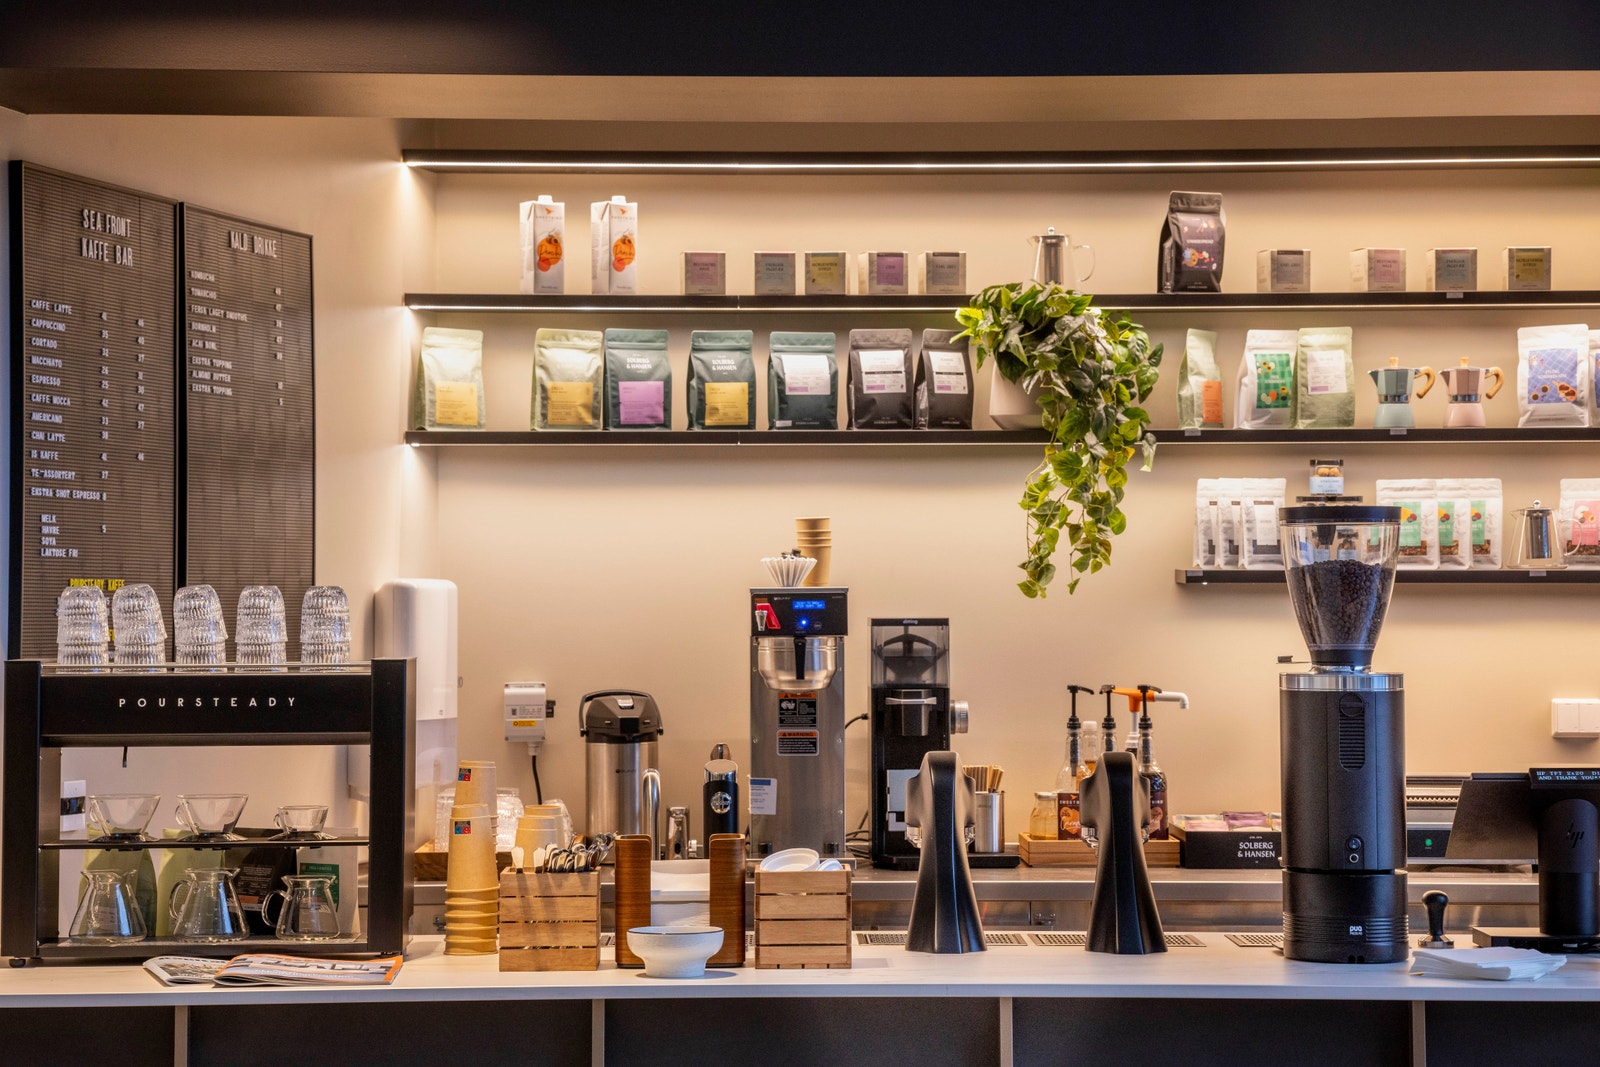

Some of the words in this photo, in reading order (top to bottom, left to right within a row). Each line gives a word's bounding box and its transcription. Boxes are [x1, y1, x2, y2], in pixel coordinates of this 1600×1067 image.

[83, 209, 101, 231] SEA
[106, 214, 131, 237] FRONT
[230, 230, 248, 251] KALD
[253, 235, 277, 258] DRIKKE
[82, 238, 109, 261] KAFFE
[115, 245, 133, 266] BAR
[191, 271, 215, 282] KOMBUCHA
[31, 300, 50, 311] CAFFE
[54, 303, 72, 314] LATTE
[31, 318, 66, 331] CAPPUCCINO
[102, 330, 109, 339] 35
[31, 337, 58, 349] CORTADO
[102, 348, 109, 357] 32
[138, 354, 144, 362] 37
[31, 355, 62, 368] MACCHIATO
[101, 366, 109, 375] 26
[192, 356, 211, 366] EKSTRA
[213, 358, 232, 369] TOPPING
[31, 374, 61, 387] ESPRESSO
[101, 380, 109, 389] 25
[192, 369, 211, 379] ALMOND
[213, 372, 231, 382] BUTTER
[192, 383, 211, 394] EKSTRA
[213, 386, 232, 396] TOPPING
[31, 393, 50, 404] CAFFE
[52, 395, 71, 406] MOCCA
[101, 399, 109, 407] 42
[31, 412, 63, 424] AMERICANO
[138, 421, 144, 429] 37
[31, 431, 45, 440] CHAI
[47, 433, 65, 442] LATTE
[31, 450, 37, 459] IS
[40, 451, 58, 460] KAFFE
[101, 471, 109, 479] 37
[31, 487, 53, 497] EKSTRA
[56, 489, 70, 498] SHOT
[73, 490, 100, 500] ESPRESSO
[41, 514, 57, 523] MELK
[41, 526, 60, 535] HAVRE
[102, 525, 107, 533] 5
[41, 537, 57, 546] SOYA
[41, 548, 67, 558] LAKTOSE
[68, 549, 79, 558] FRI
[119, 698, 295, 707] POURSTEADY
